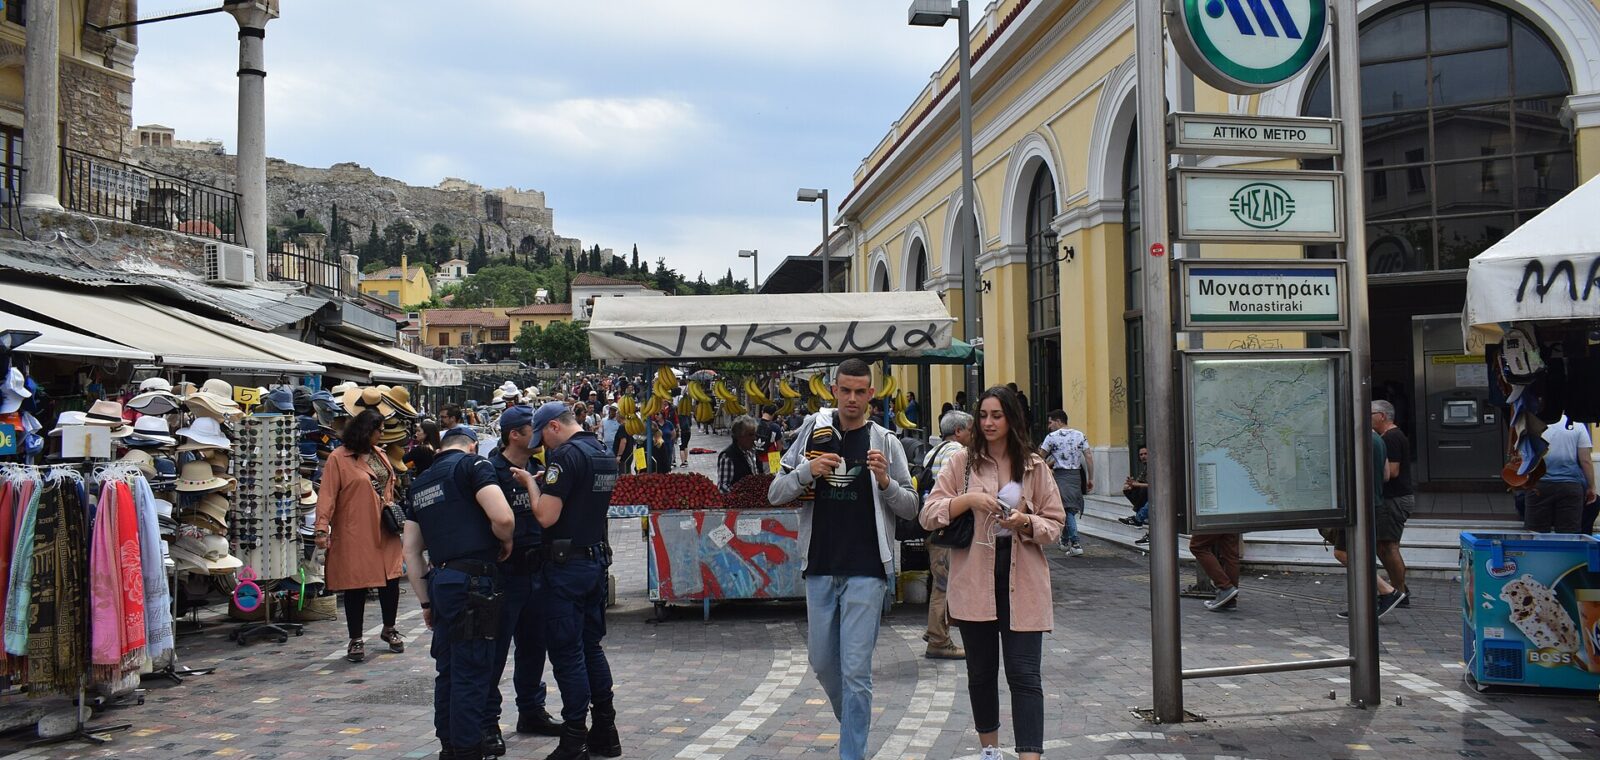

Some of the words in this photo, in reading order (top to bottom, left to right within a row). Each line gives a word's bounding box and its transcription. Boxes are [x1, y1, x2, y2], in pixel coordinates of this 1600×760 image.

[1213, 126, 1257, 139] ΑΤΤΙΚΟ
[1263, 128, 1306, 141] ΜΕΤΡΟ
[1241, 189, 1284, 222] ΗΣΑΠ
[1198, 279, 1330, 299] Μοναστηράκι
[1229, 300, 1303, 312] Monastiraki
[241, 388, 257, 402] 5
[1529, 652, 1571, 663] BOSS
